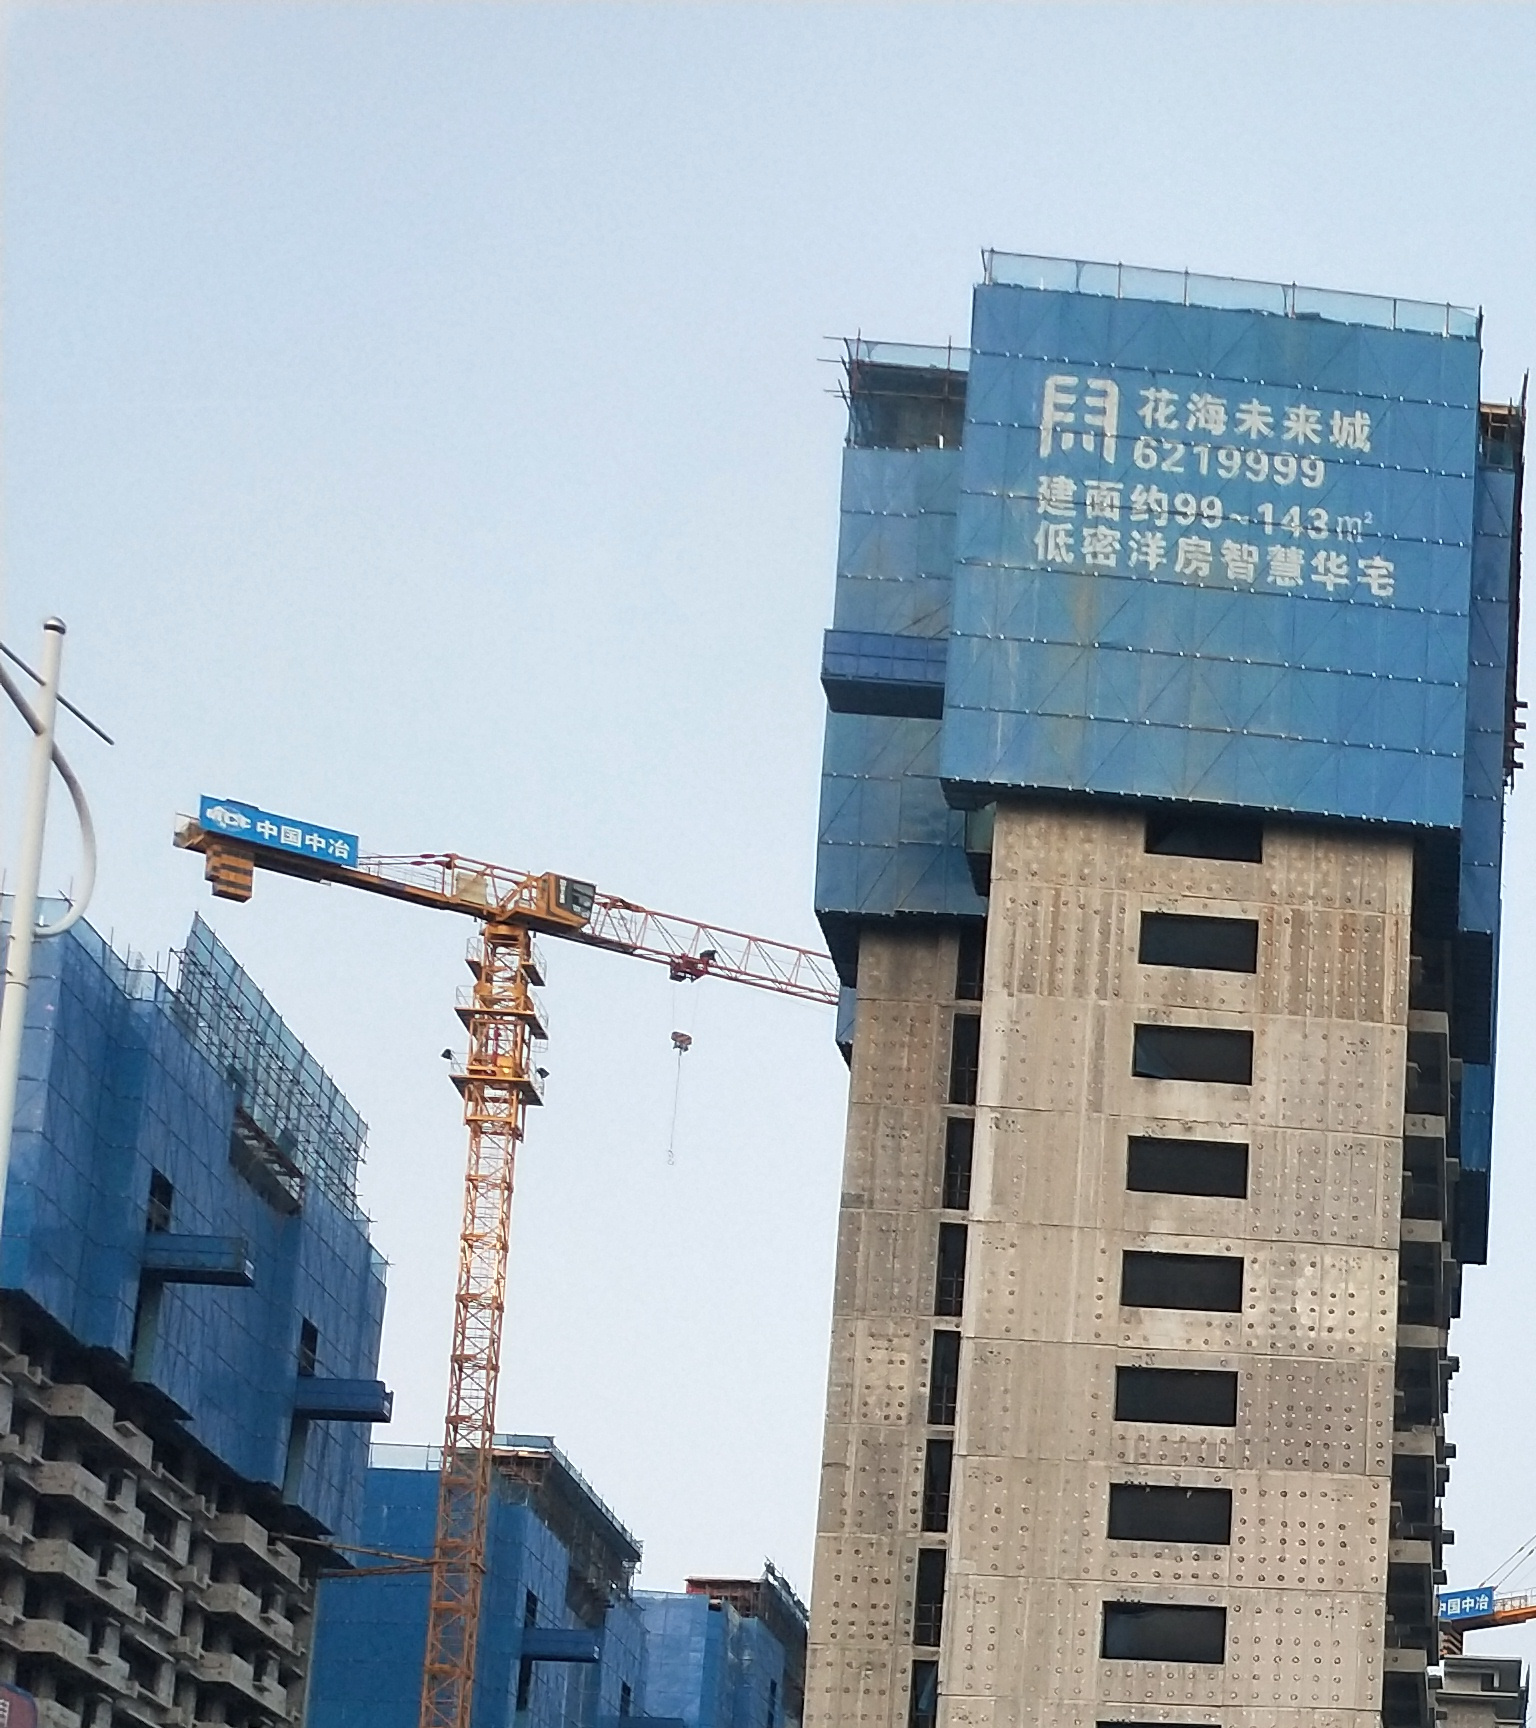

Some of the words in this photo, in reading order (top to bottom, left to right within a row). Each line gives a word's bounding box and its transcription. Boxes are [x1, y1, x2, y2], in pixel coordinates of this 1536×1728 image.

[1138, 386, 1372, 454] 花海未来城
[1132, 436, 1326, 490] 6219999
[1033, 519, 1395, 598] 低密洋房智慧华宅
[256, 819, 350, 860] 中国中冶
